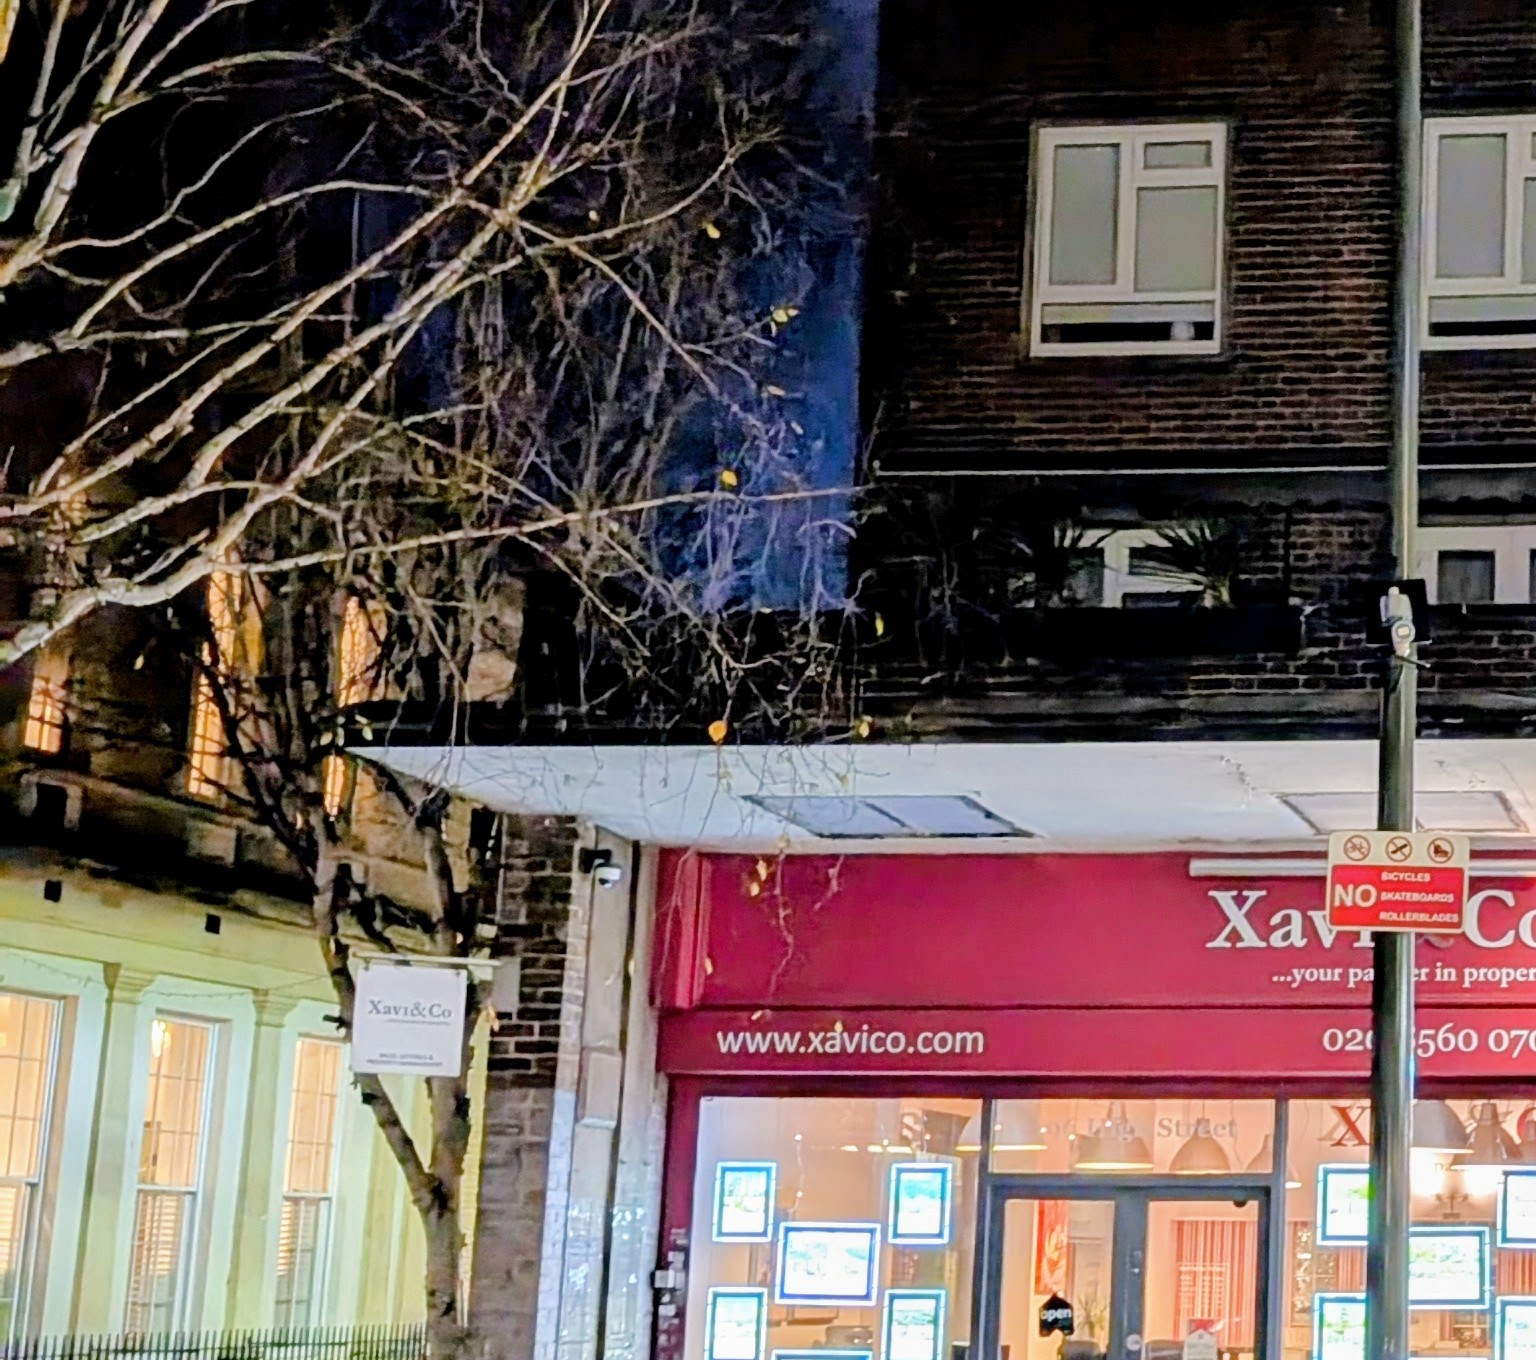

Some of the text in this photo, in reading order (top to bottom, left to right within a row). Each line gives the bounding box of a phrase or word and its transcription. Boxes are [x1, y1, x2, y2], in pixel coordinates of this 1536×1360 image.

[1381, 871, 1430, 882] BICYCLES
[1334, 884, 1377, 907] NO
[1380, 891, 1454, 902] SKATEBOARDS
[1379, 911, 1459, 923] ROLLERBLADES
[1435, 962, 1457, 982] in
[717, 1024, 984, 1054] www.xavico.com
[1041, 1308, 1073, 1322] open
